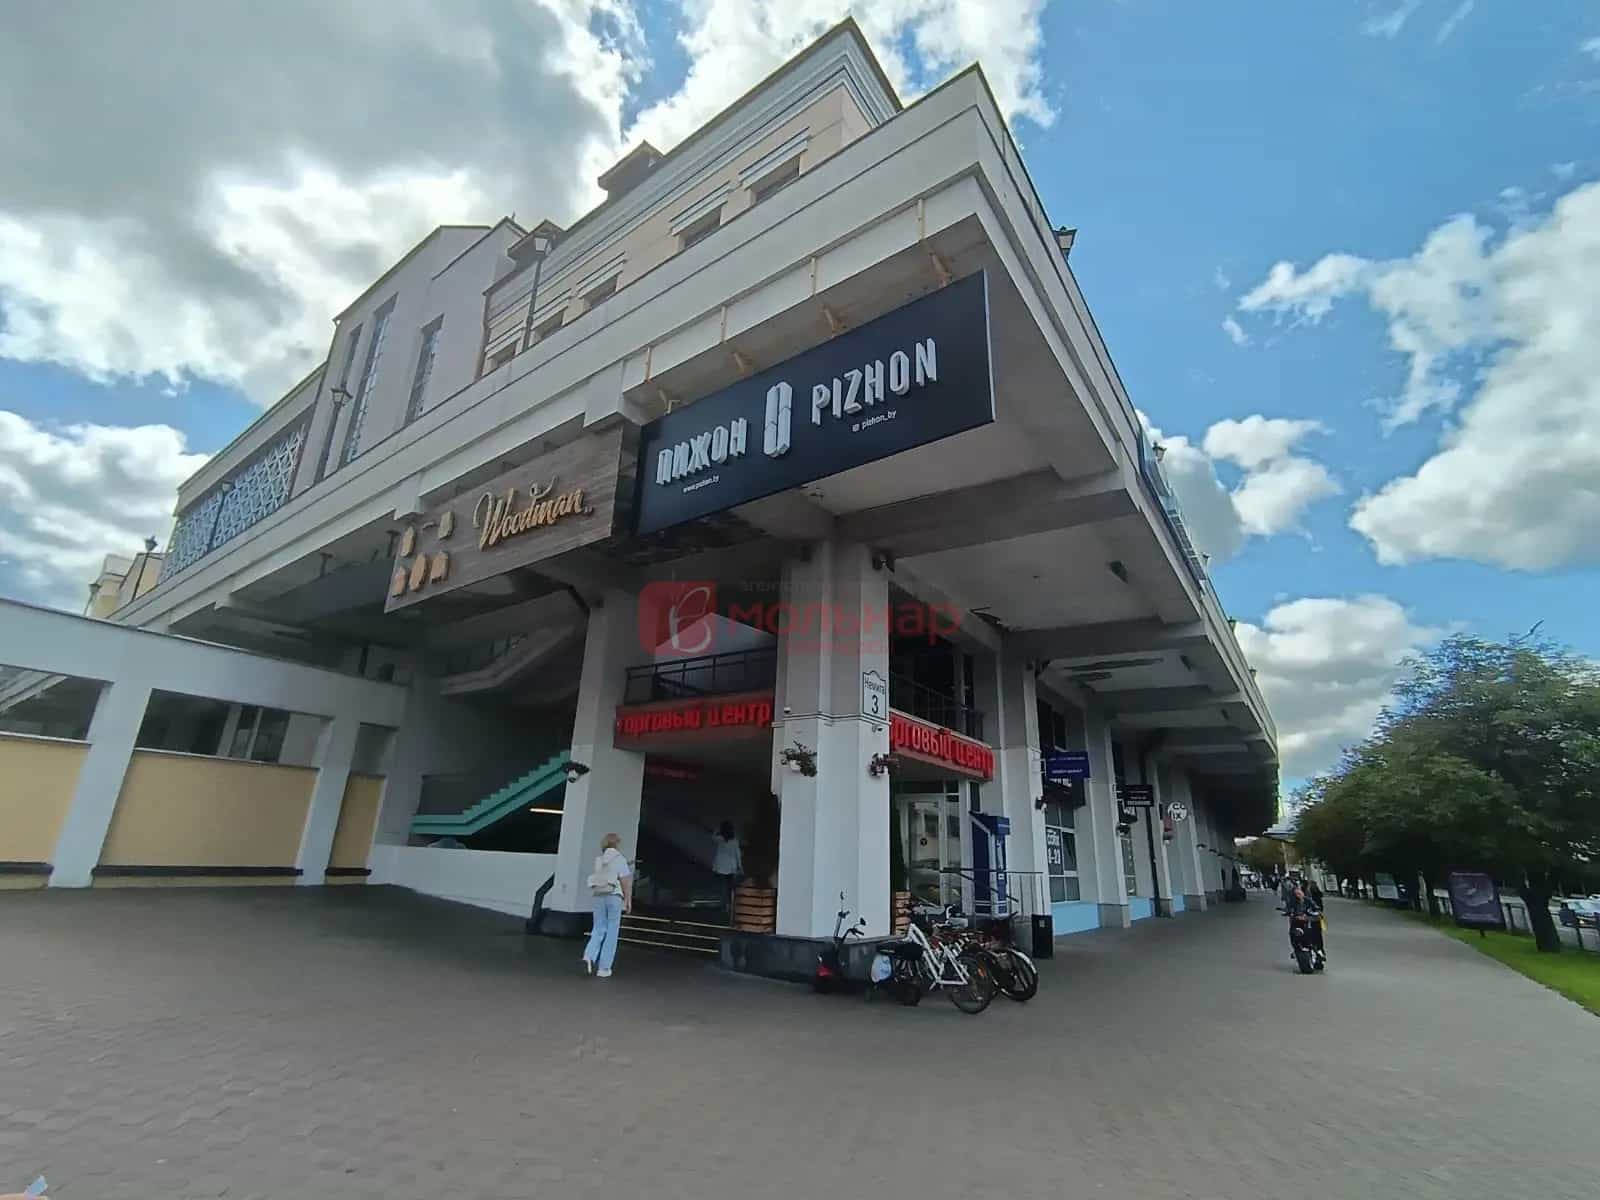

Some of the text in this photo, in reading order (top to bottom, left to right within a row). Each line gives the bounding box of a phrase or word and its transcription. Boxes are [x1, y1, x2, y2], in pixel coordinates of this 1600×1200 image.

[811, 337, 939, 426] PIZHON
[656, 417, 748, 485] ПИЖОН
[872, 694, 879, 714] 3
